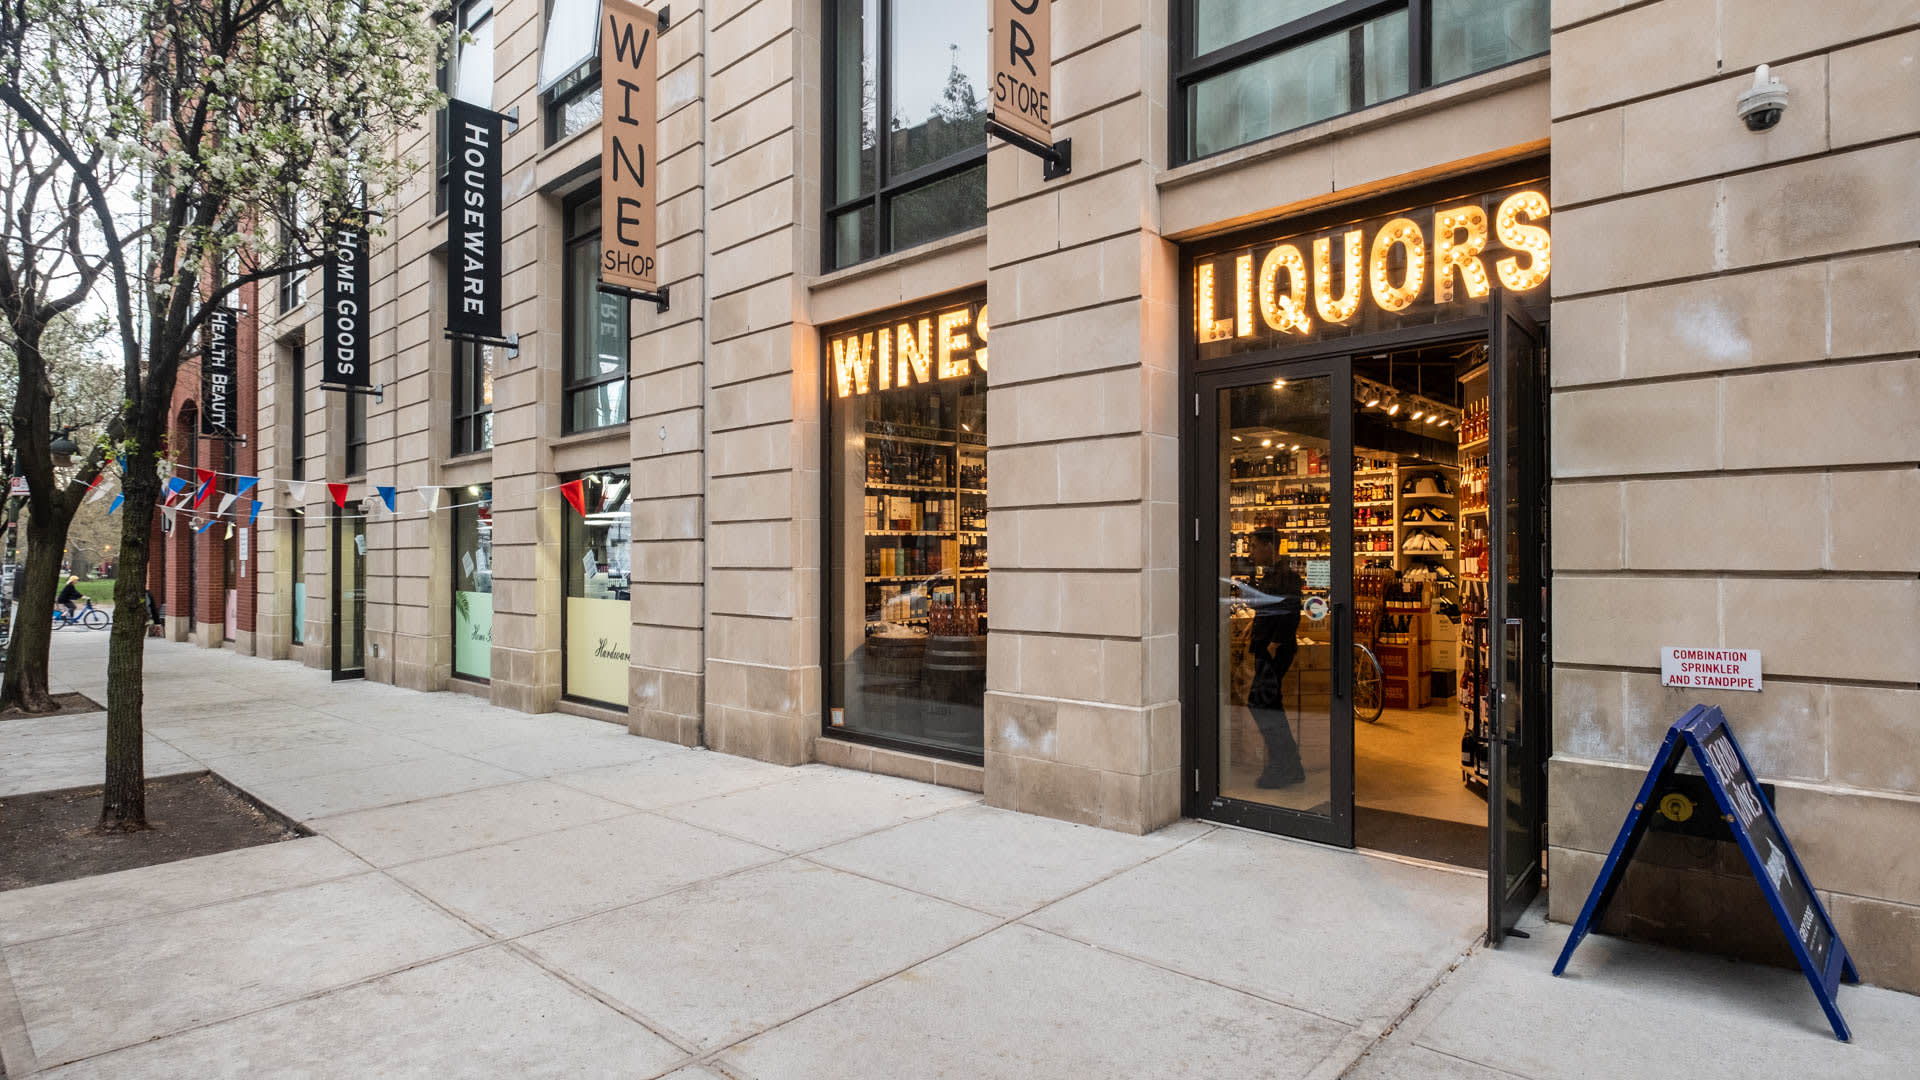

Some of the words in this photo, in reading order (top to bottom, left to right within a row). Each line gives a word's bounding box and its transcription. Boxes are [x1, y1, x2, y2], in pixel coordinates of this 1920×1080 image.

[996, 72, 1049, 125] STORE
[609, 14, 650, 247] WINE
[463, 121, 489, 316] HOUSEWARE
[337, 230, 358, 294] HOME
[604, 250, 655, 278] SHOP
[1199, 190, 1551, 344] LIQUORS
[211, 311, 228, 368] HEALTH
[337, 299, 358, 375] GOODS
[211, 373, 228, 429] BEAUTY
[1669, 674, 1690, 685] AND
[1694, 675, 1755, 688] STANDPIPE
[1673, 649, 1748, 662] COMBINATION
[1681, 662, 1740, 675] SPRINKLER
